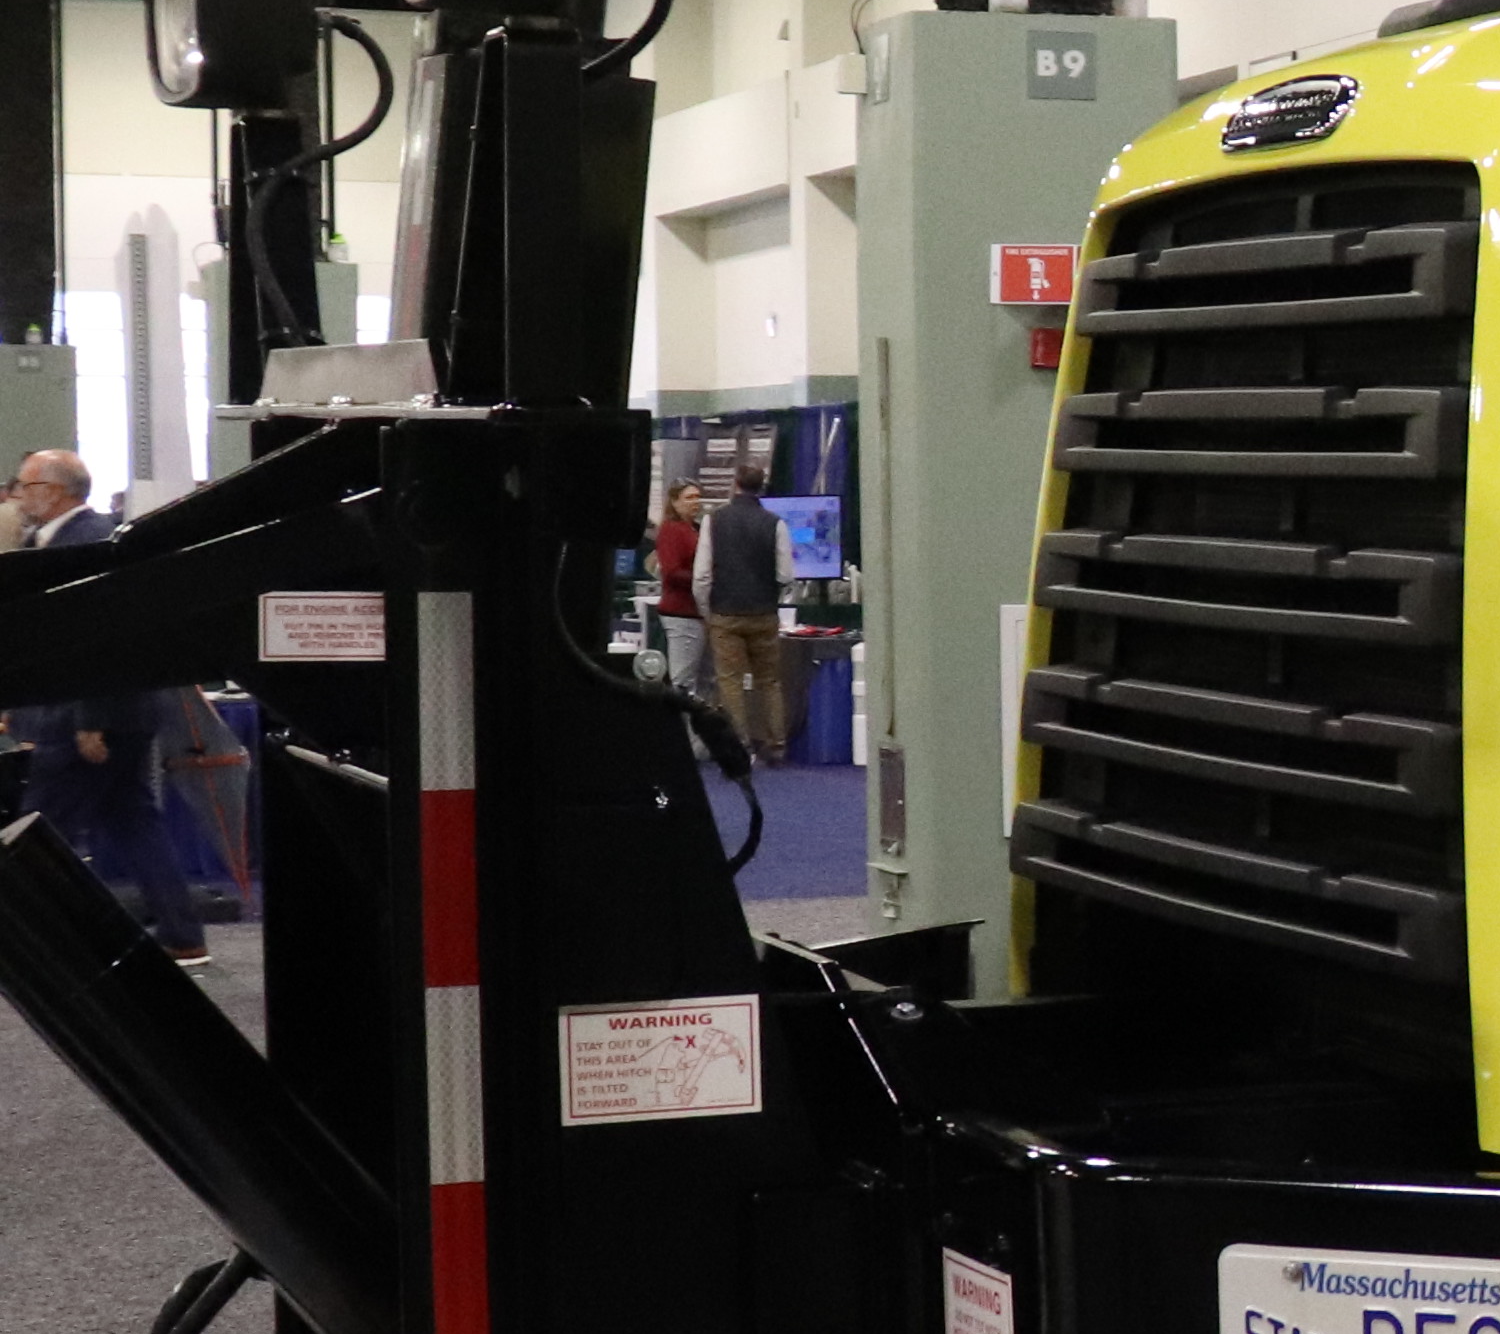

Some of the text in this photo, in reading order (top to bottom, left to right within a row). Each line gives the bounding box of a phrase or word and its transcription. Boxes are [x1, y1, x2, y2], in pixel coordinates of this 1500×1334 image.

[1035, 48, 1086, 78] B9
[608, 1013, 713, 1030] WARNING
[576, 1038, 653, 1053] STAY OUT OF
[577, 1054, 638, 1067] THIS AREA
[577, 1067, 652, 1082] WHEN HITCH
[577, 1083, 629, 1096] IS TILTED
[577, 1098, 638, 1110] FORWARD
[952, 1273, 1002, 1315] WARNING
